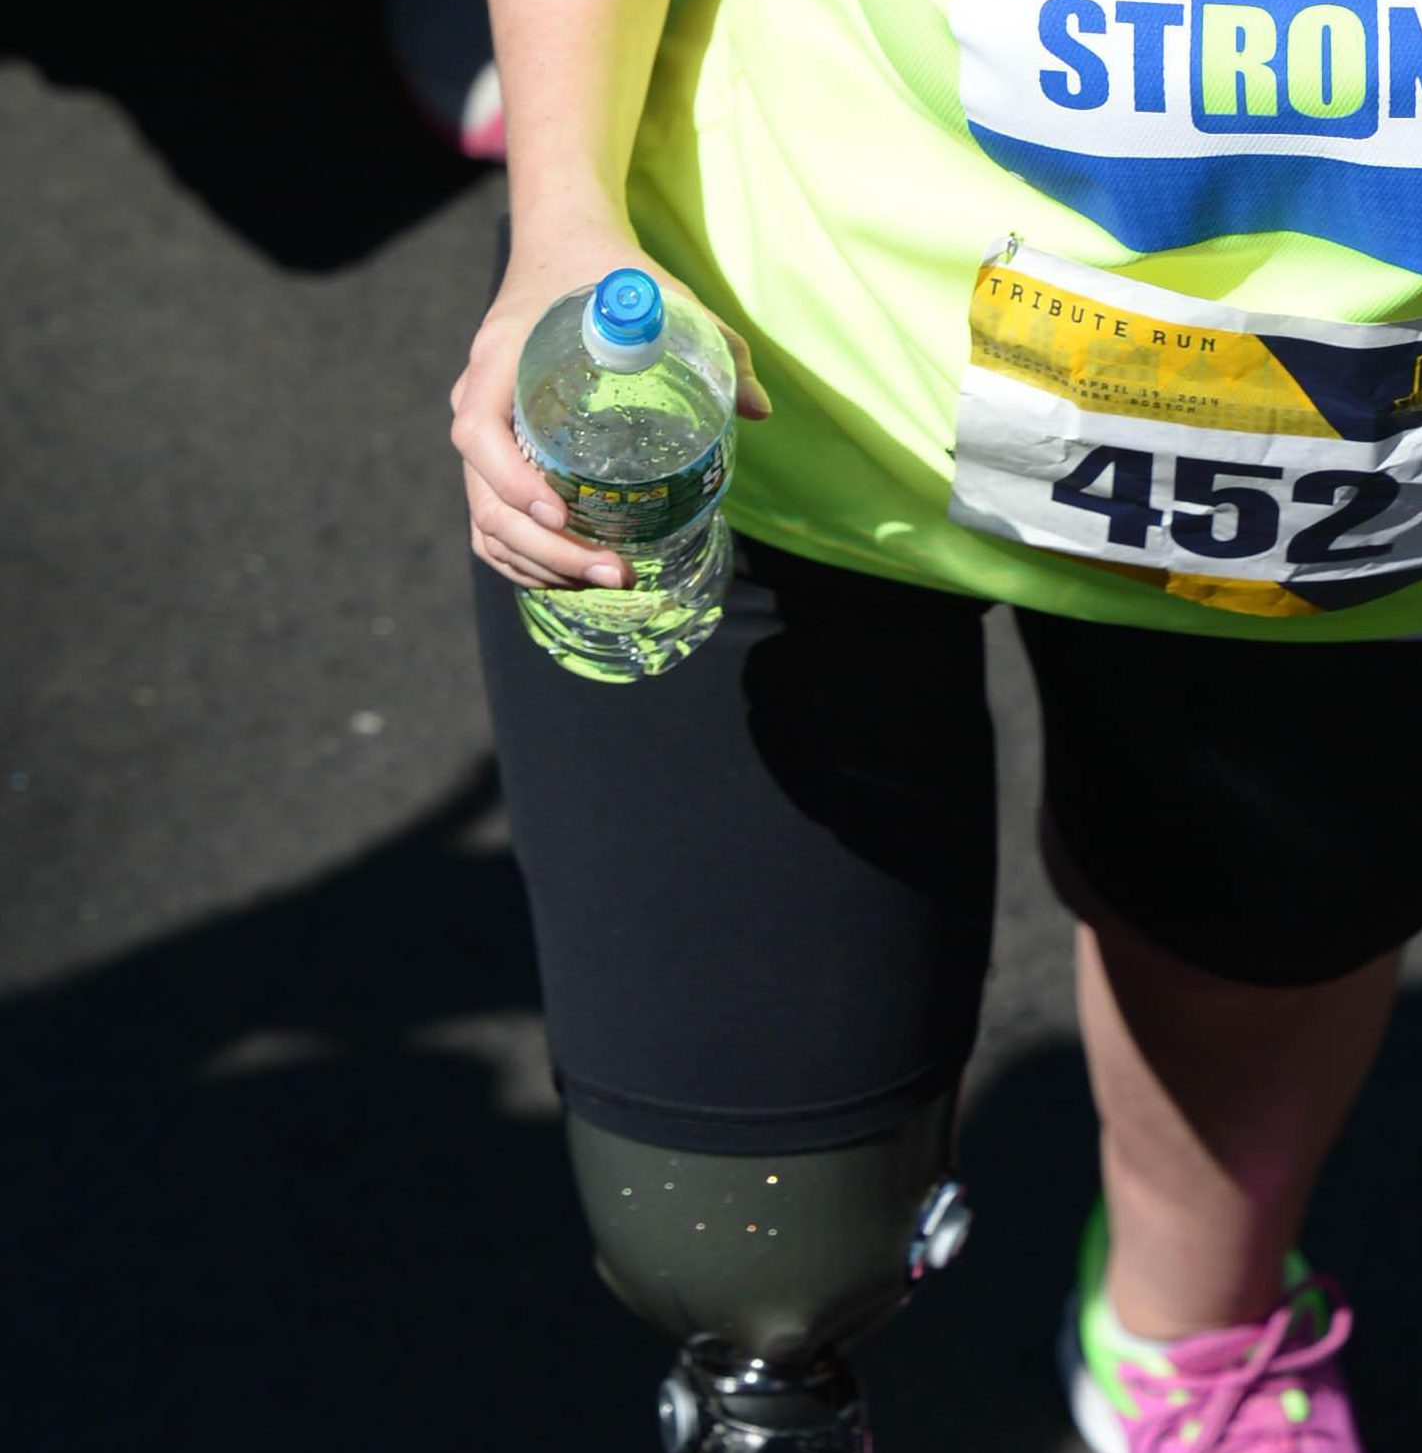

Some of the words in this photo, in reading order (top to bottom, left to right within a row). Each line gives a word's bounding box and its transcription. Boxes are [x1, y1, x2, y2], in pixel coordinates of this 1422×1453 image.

[989, 278, 1129, 338] TRIBUTE
[1151, 329, 1217, 353] RUN
[1078, 378, 1129, 395] APRIL
[1177, 393, 1220, 408] 2014
[1129, 397, 1197, 414] BOSTON
[1051, 443, 1403, 565] 452
